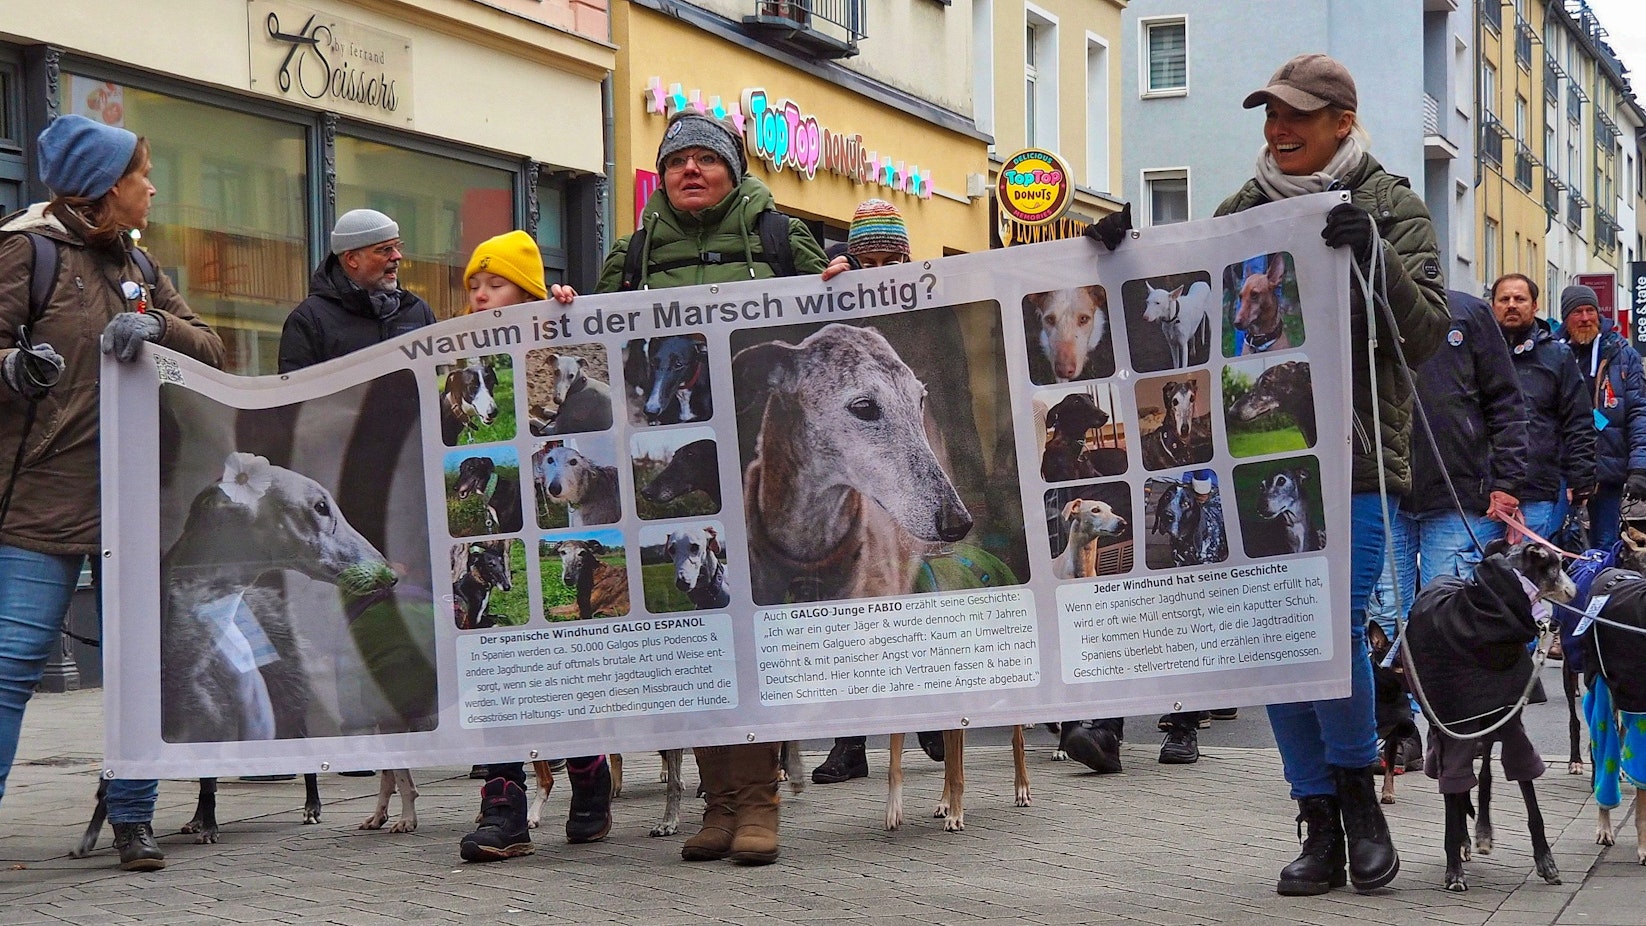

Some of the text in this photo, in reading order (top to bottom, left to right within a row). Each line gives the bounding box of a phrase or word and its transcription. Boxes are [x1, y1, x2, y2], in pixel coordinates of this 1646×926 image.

[335, 37, 385, 65] by ferrand
[298, 26, 399, 112] Scissors
[1013, 153, 1053, 165] DELICIOUS
[1013, 210, 1052, 221] MEMORIES
[399, 273, 937, 361] Warum ist der Marsch wichtig?
[1094, 563, 1287, 593] Jeder Windhund hat seine Geschichte
[763, 592, 1020, 621] Auch GALGO-Junge FABIO erzählt seine Geschichte:
[1064, 576, 1322, 612] Wenn ein spanischer Jagdhund seinen Dienst erfüllt hat,
[786, 627, 804, 635] war
[807, 624, 822, 633] ein
[824, 623, 850, 634] guter
[853, 620, 879, 631] Jäger
[893, 616, 922, 627] wurde
[925, 612, 965, 624] dennoch
[969, 611, 984, 621] mit
[995, 608, 1027, 619] Jahren
[1073, 594, 1317, 628] wird oft wie Müll entsorgt, wie ein kaputter Schuh.
[480, 617, 705, 644] Der spanische Windhund GALGO ESPANOL
[760, 623, 1032, 653] von meinem Galguero abgeschafft: Kaum an Umweltreize
[1081, 613, 1313, 644] Hier kommen Hunde Wort, die die Jagdtradition
[470, 634, 707, 662] In Spanien werden ca. 50.000 Galgos plus Podencos
[759, 638, 1036, 671] gewöhnt mit panischer Angst vor Männern kam ich nach
[1081, 630, 1316, 662] Spaniens überlebt haben, und erzählen ihre eigene
[465, 647, 725, 677] andere Jagdhunde auf oftmals brutale Art und Weise ent-
[765, 655, 1032, 684] Deutschland. Hier konnte ich Vertrauen fassen habe in
[1073, 647, 1321, 677] Geschichte stellvertretend für ihre Leidensgenossen.
[476, 664, 712, 693] sorgt, wenn sie als nicht mehr jagdtauglich erachtet
[500, 695, 515, 705] Wir
[518, 692, 573, 706] protestieren
[576, 689, 606, 701] gegen
[608, 686, 639, 696] diesen
[642, 680, 693, 694] Missbrauch
[696, 679, 714, 689] und
[716, 678, 731, 688] die
[760, 690, 793, 701] kleinen
[795, 687, 837, 698] Schritten
[847, 684, 868, 694] über
[871, 683, 886, 693] die
[889, 681, 914, 692] Jahre
[924, 678, 951, 689] meine
[954, 675, 986, 688] Ängste
[520, 709, 564, 719] Haltungs-
[567, 705, 586, 715] und
[588, 700, 675, 714] Zuchtbedingungen
[678, 696, 694, 706] der
[696, 694, 729, 705] Hunde.
